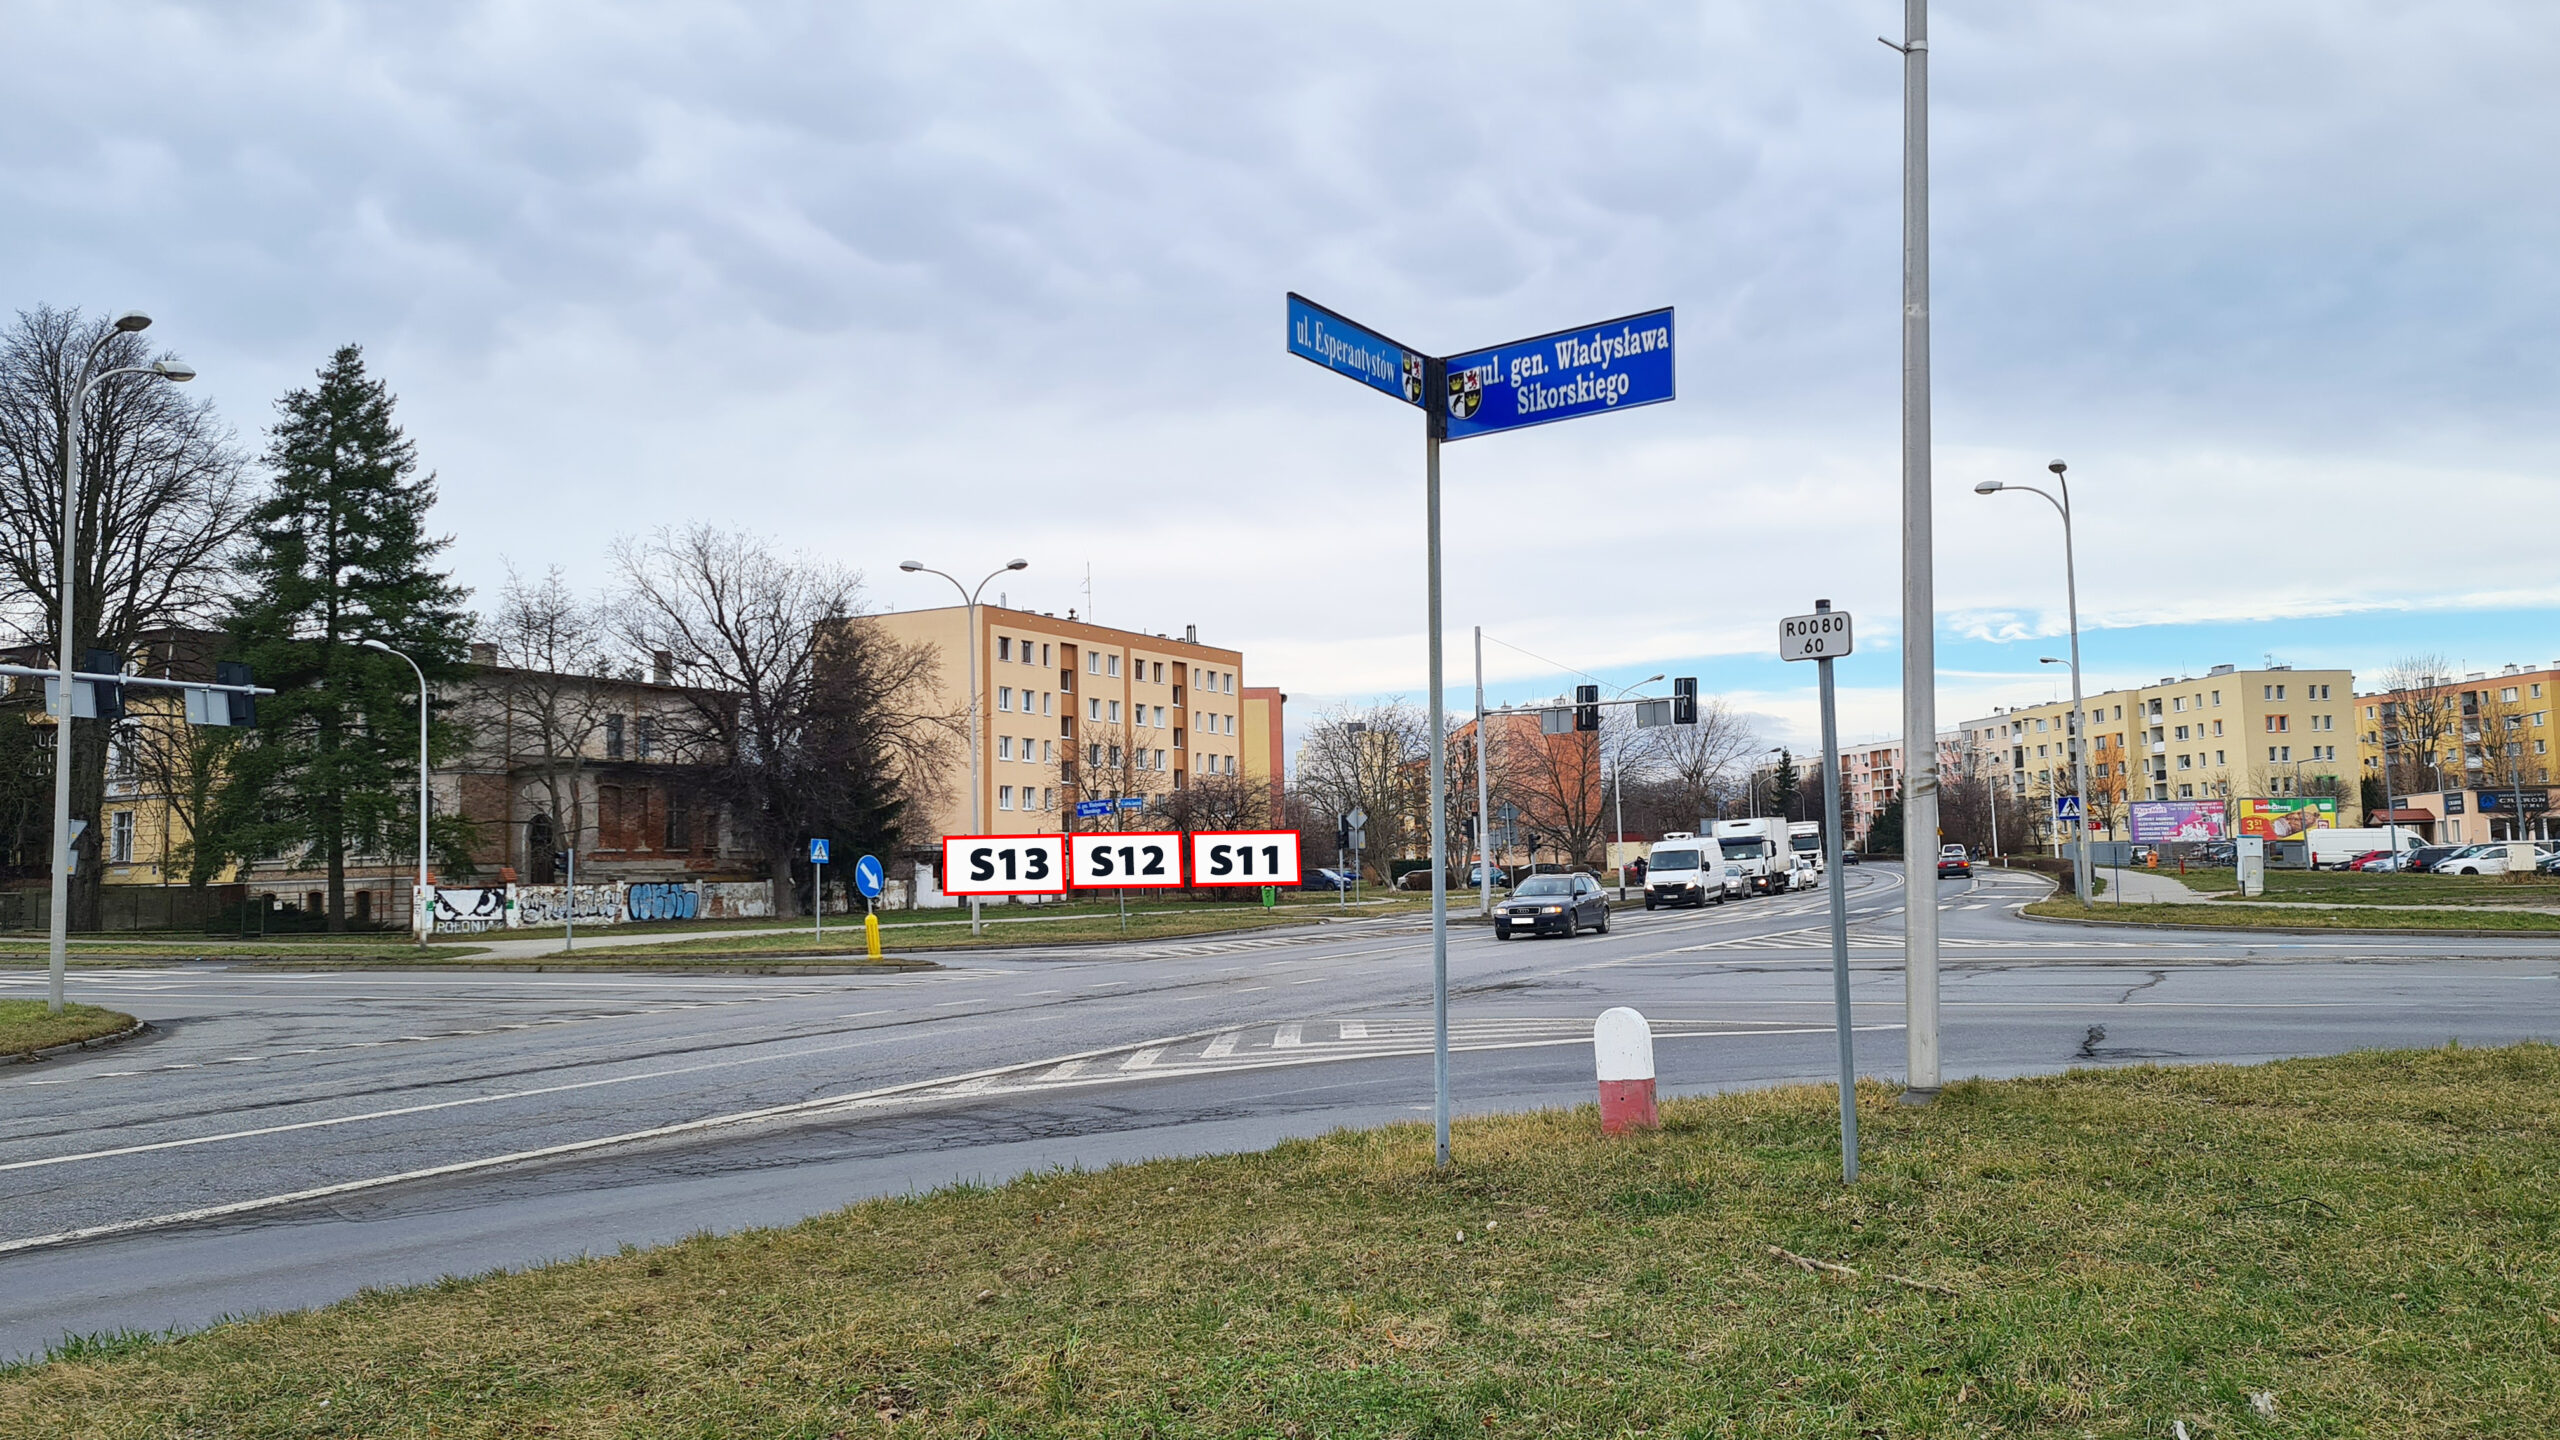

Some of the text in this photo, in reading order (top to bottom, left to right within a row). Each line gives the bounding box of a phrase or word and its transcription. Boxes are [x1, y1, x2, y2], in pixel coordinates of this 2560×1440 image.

[1297, 315, 1396, 384] ul. Esperantystów
[1481, 326, 1669, 388] ul. gen. Władysława
[1516, 371, 1630, 415] Sikorskiego
[1786, 617, 1843, 637] R0080
[2246, 820, 2254, 830] 3
